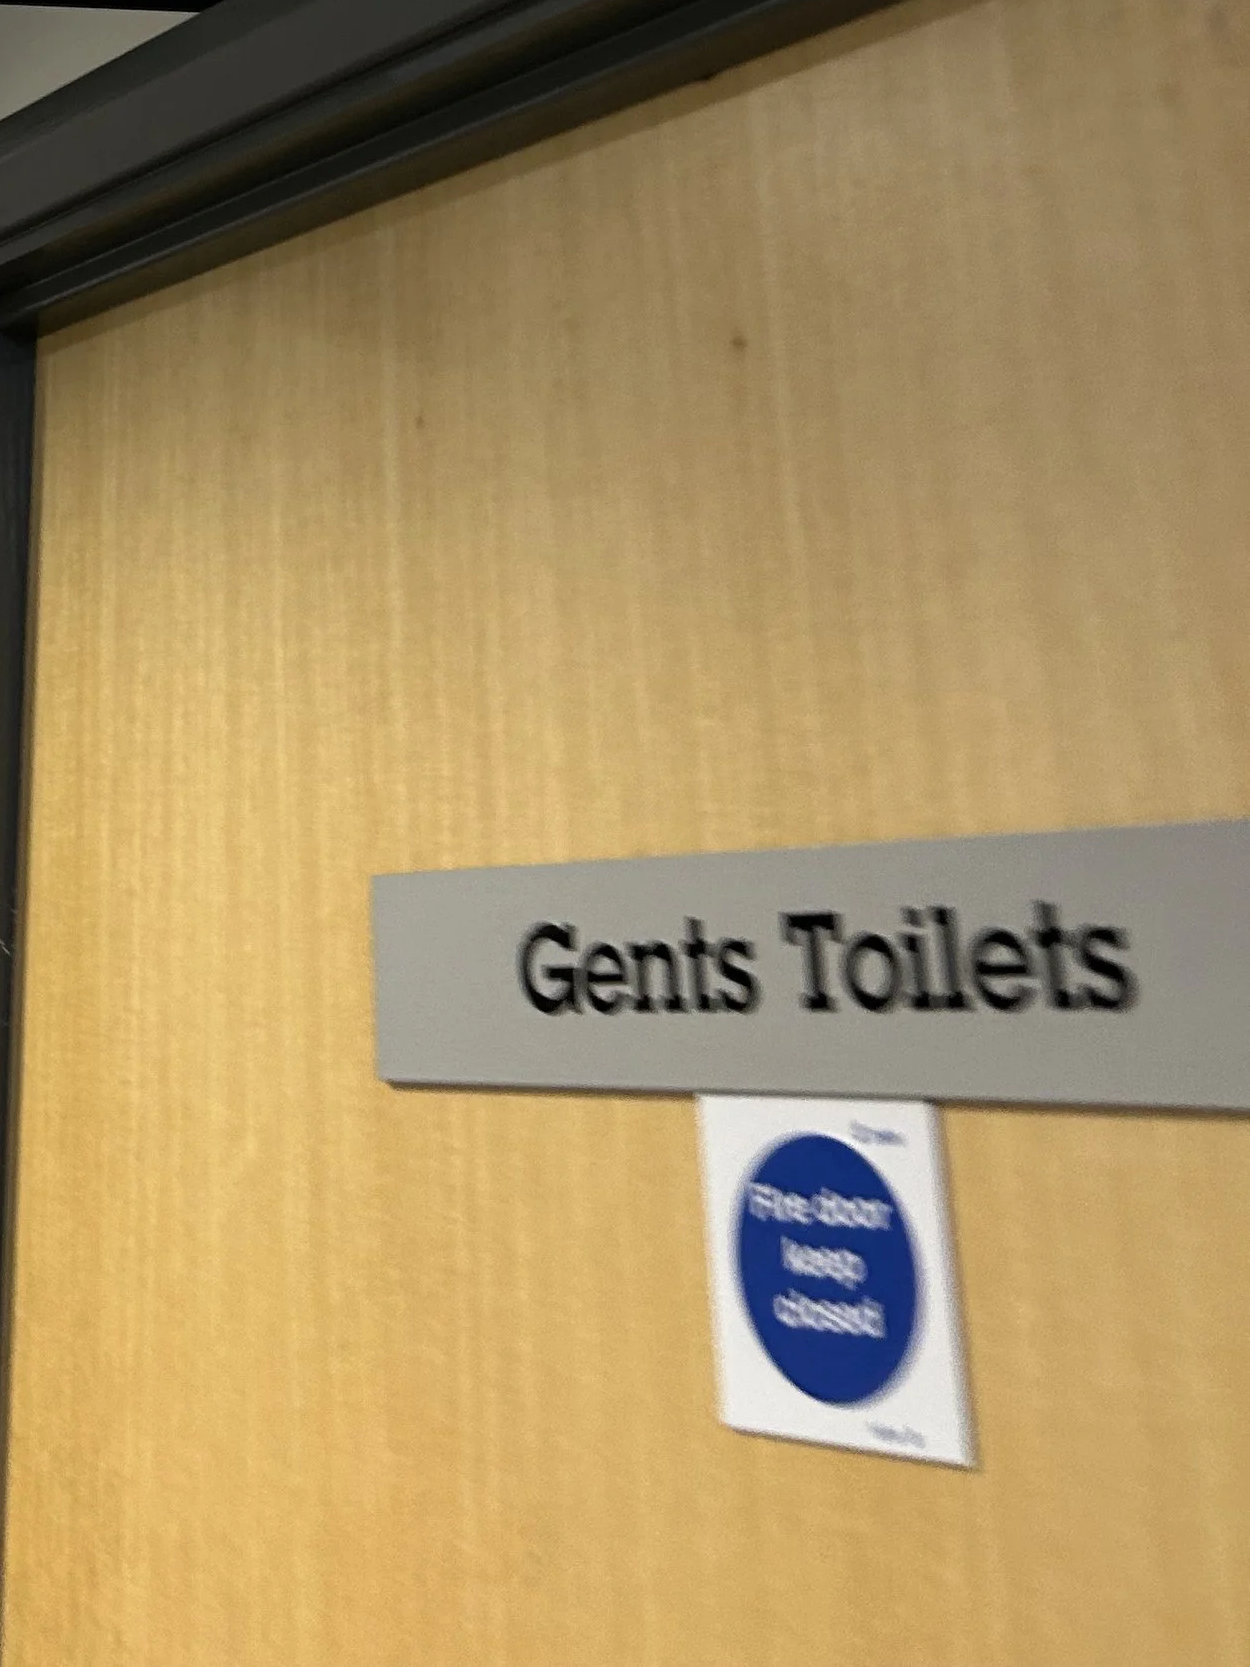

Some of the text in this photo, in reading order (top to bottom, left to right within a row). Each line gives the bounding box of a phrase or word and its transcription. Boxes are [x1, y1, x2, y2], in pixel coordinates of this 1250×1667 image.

[519, 900, 1138, 1014] Gents Toilets
[749, 1181, 893, 1232] Fire door
[779, 1235, 869, 1291] keep
[772, 1287, 888, 1339] closed
